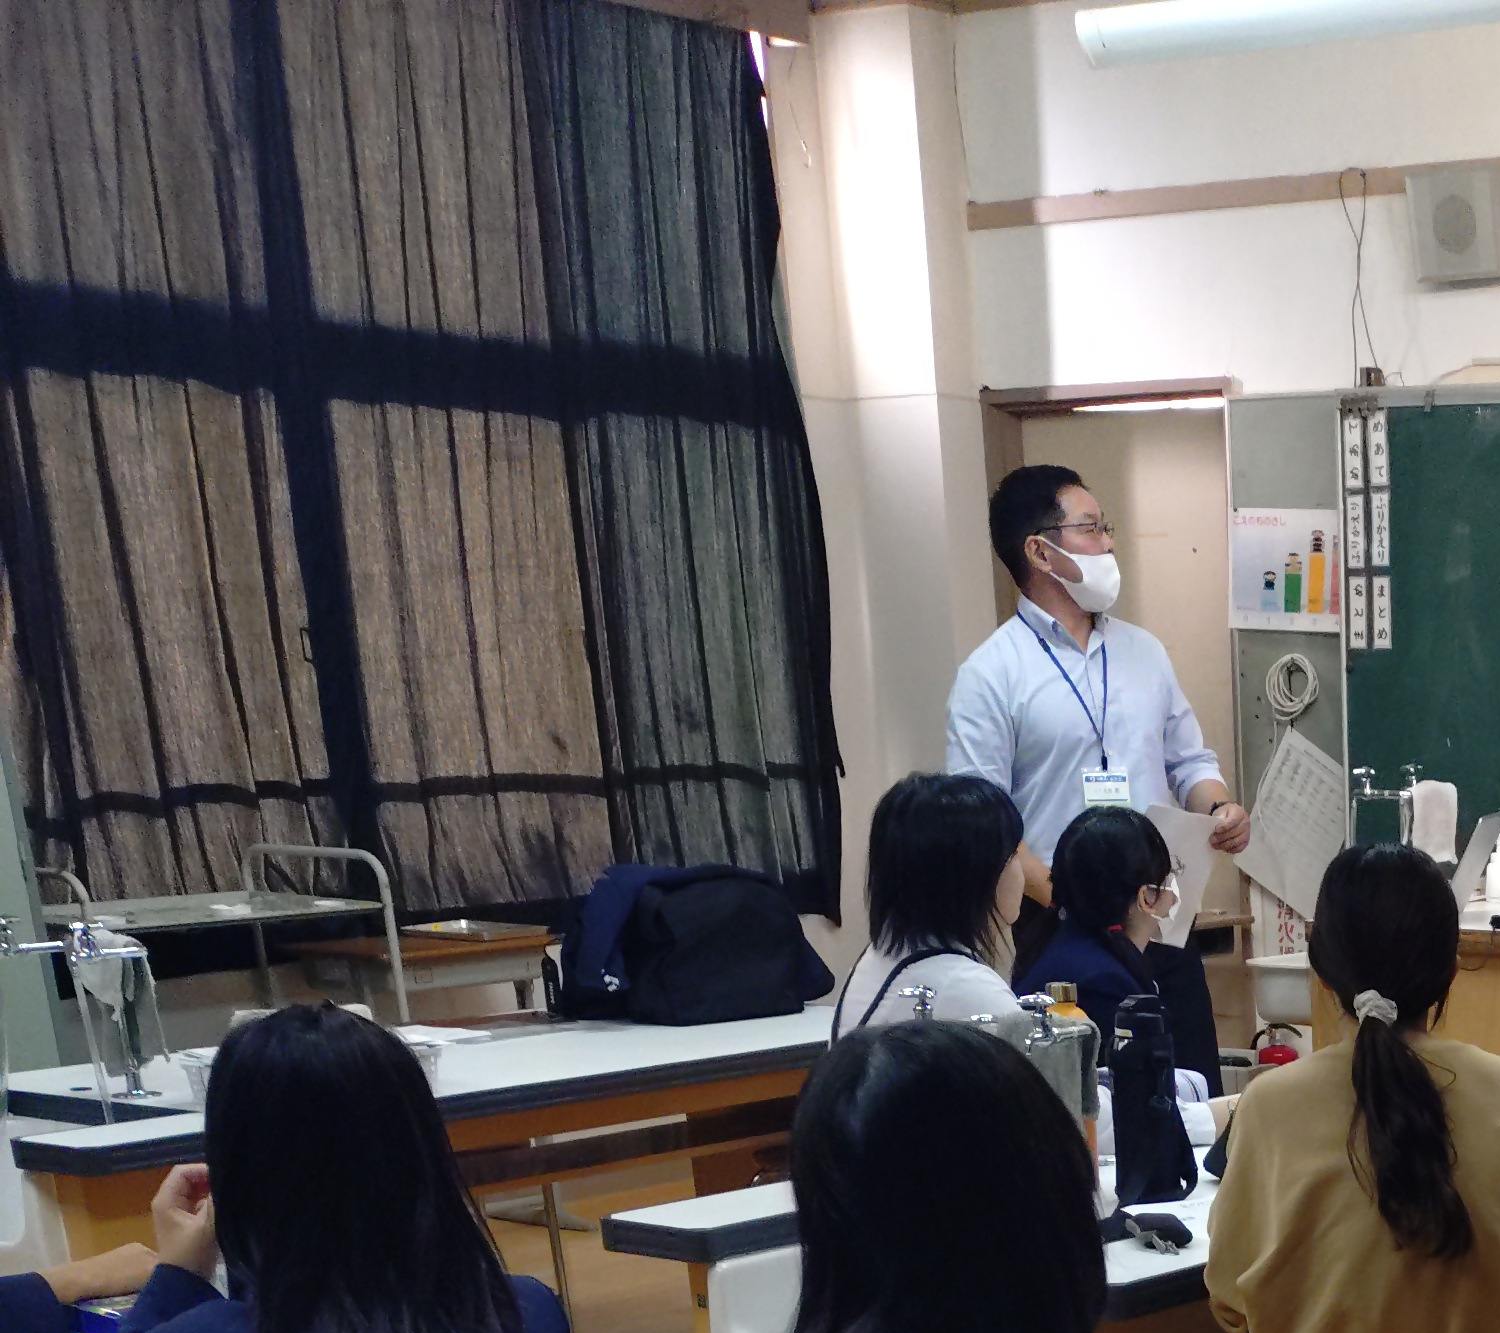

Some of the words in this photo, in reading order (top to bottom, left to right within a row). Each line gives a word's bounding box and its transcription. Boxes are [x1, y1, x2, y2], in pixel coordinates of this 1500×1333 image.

[1373, 421, 1385, 477] めあて
[1376, 496, 1386, 562] ふりかえり
[1376, 583, 1388, 640] まとめ
